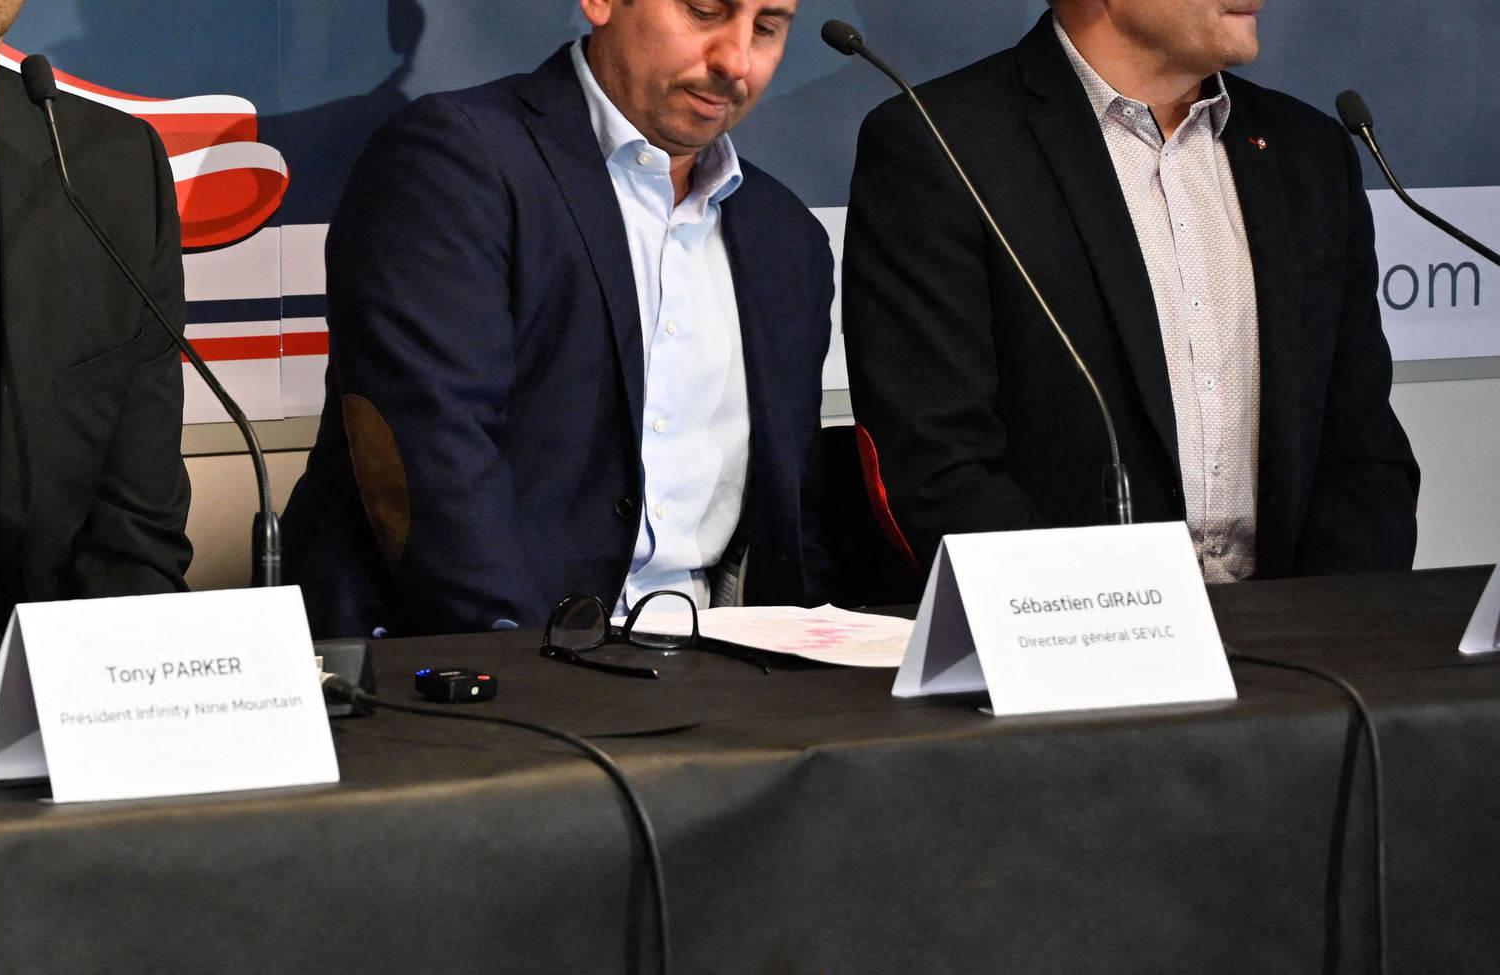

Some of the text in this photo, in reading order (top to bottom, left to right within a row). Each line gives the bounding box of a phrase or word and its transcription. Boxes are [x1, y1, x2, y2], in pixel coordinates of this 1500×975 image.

[1009, 588, 1163, 615] Sébastien GIRAUD
[1018, 624, 1175, 649] Directeur général SEVLC
[106, 656, 243, 686] Tony PARKER
[59, 694, 304, 727] Président Infinity Nine Mountain
